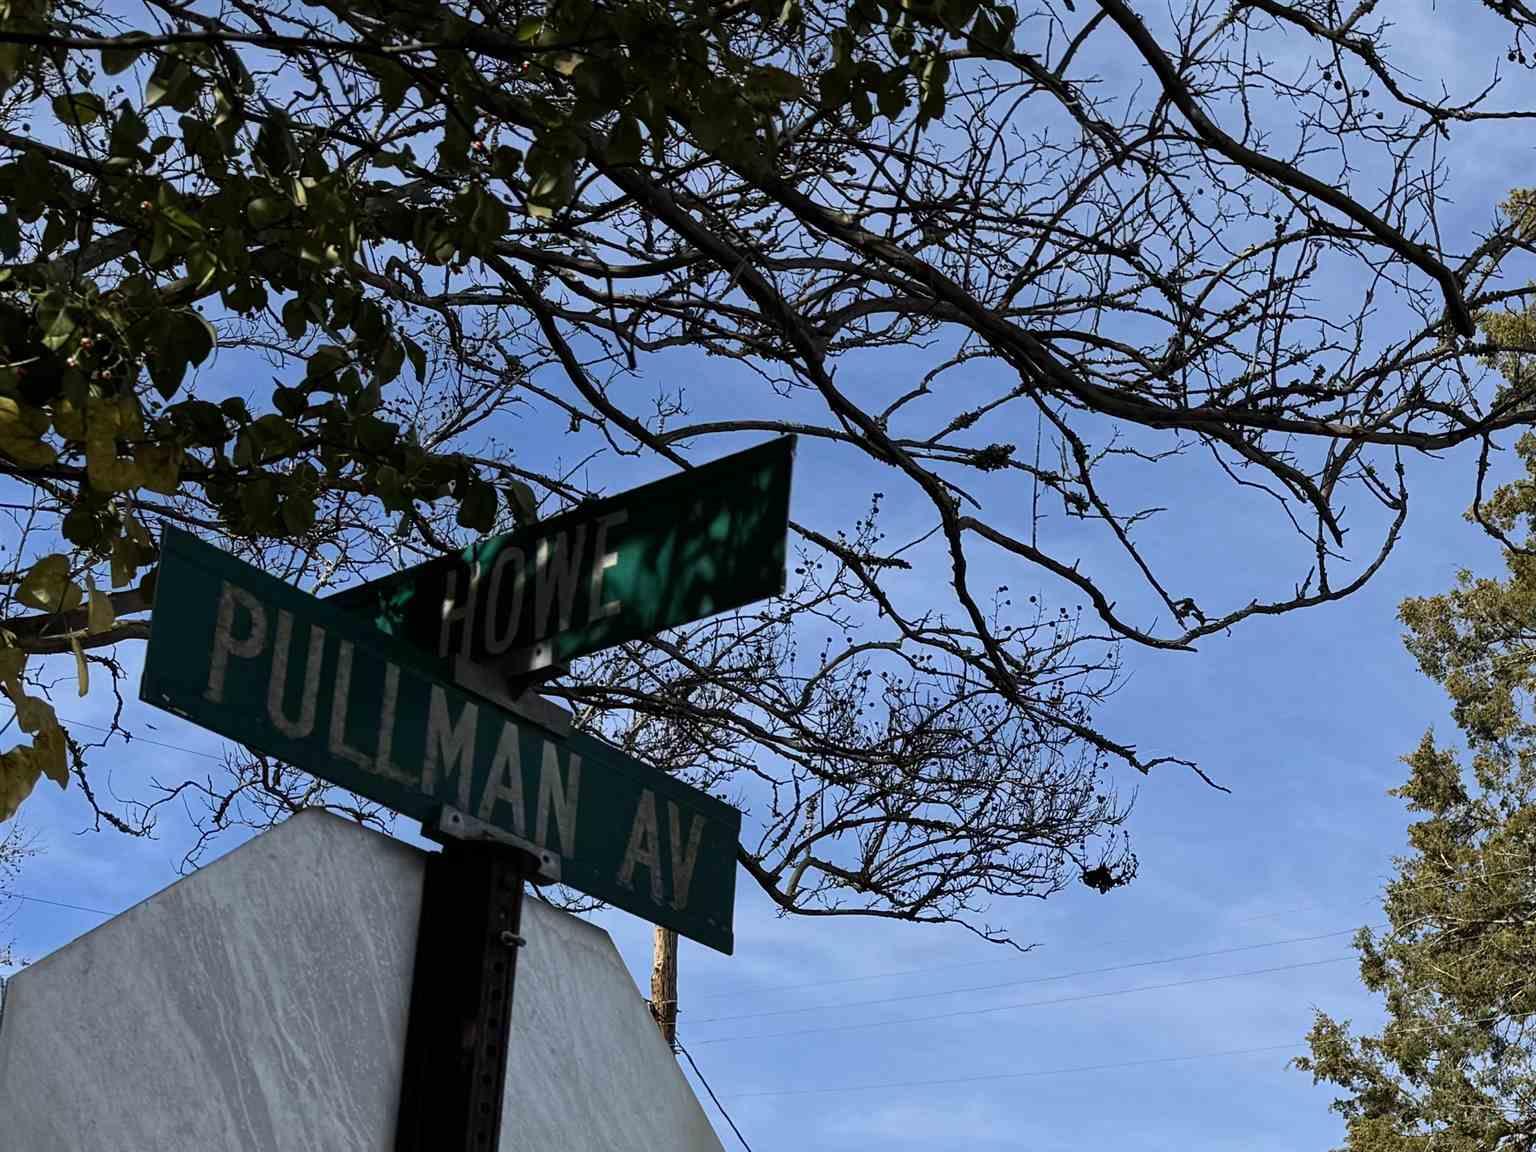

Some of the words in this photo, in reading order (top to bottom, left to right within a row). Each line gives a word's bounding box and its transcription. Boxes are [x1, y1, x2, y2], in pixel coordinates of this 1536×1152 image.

[439, 511, 628, 658] HOWE
[204, 580, 584, 859] PULLMAN
[615, 789, 707, 911] AV
